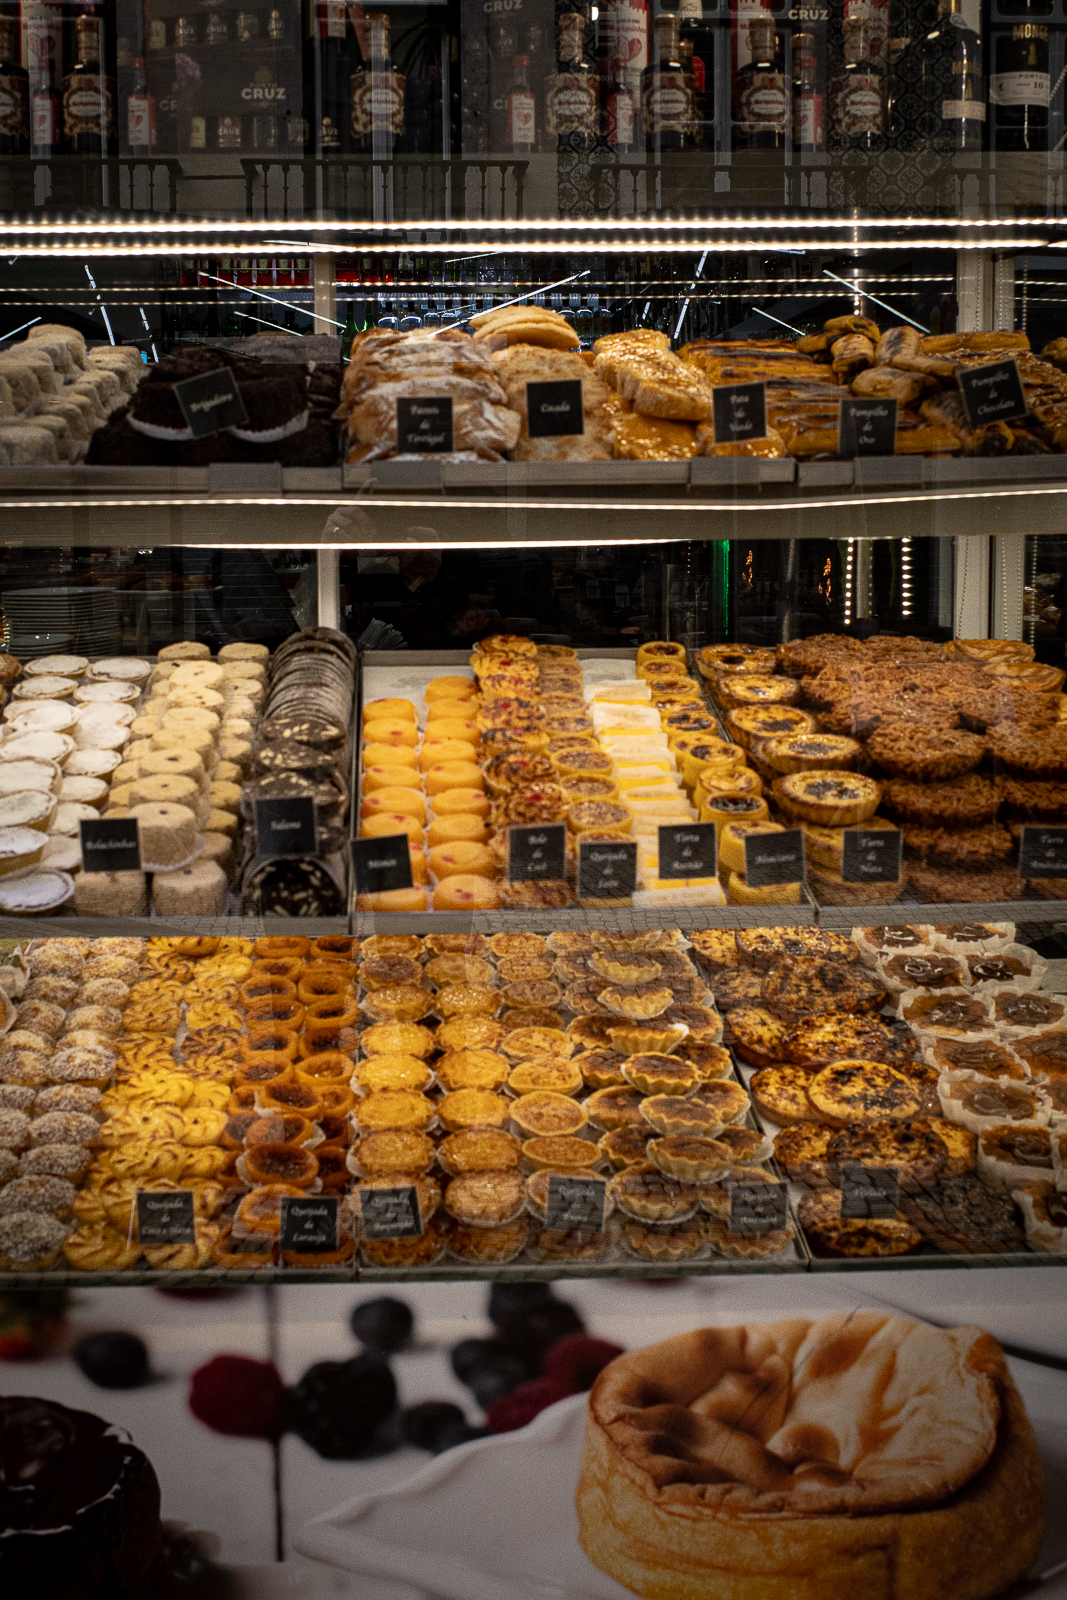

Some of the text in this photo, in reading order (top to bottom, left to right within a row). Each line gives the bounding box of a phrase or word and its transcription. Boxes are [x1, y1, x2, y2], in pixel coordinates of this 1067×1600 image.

[483, 0, 523, 13] CRUZ
[788, 9, 829, 21] CRUZ
[240, 87, 287, 100] CRUZ
[988, 387, 999, 399] de
[734, 407, 746, 418] de
[419, 417, 430, 430] de
[862, 420, 873, 432] de
[532, 847, 544, 859] de
[680, 845, 693, 858] de
[866, 849, 878, 861] de
[1045, 847, 1057, 858] de
[602, 865, 614, 876] de
[160, 1212, 172, 1223] de
[290, 1204, 329, 1221] Queijada
[303, 1219, 315, 1231] de
